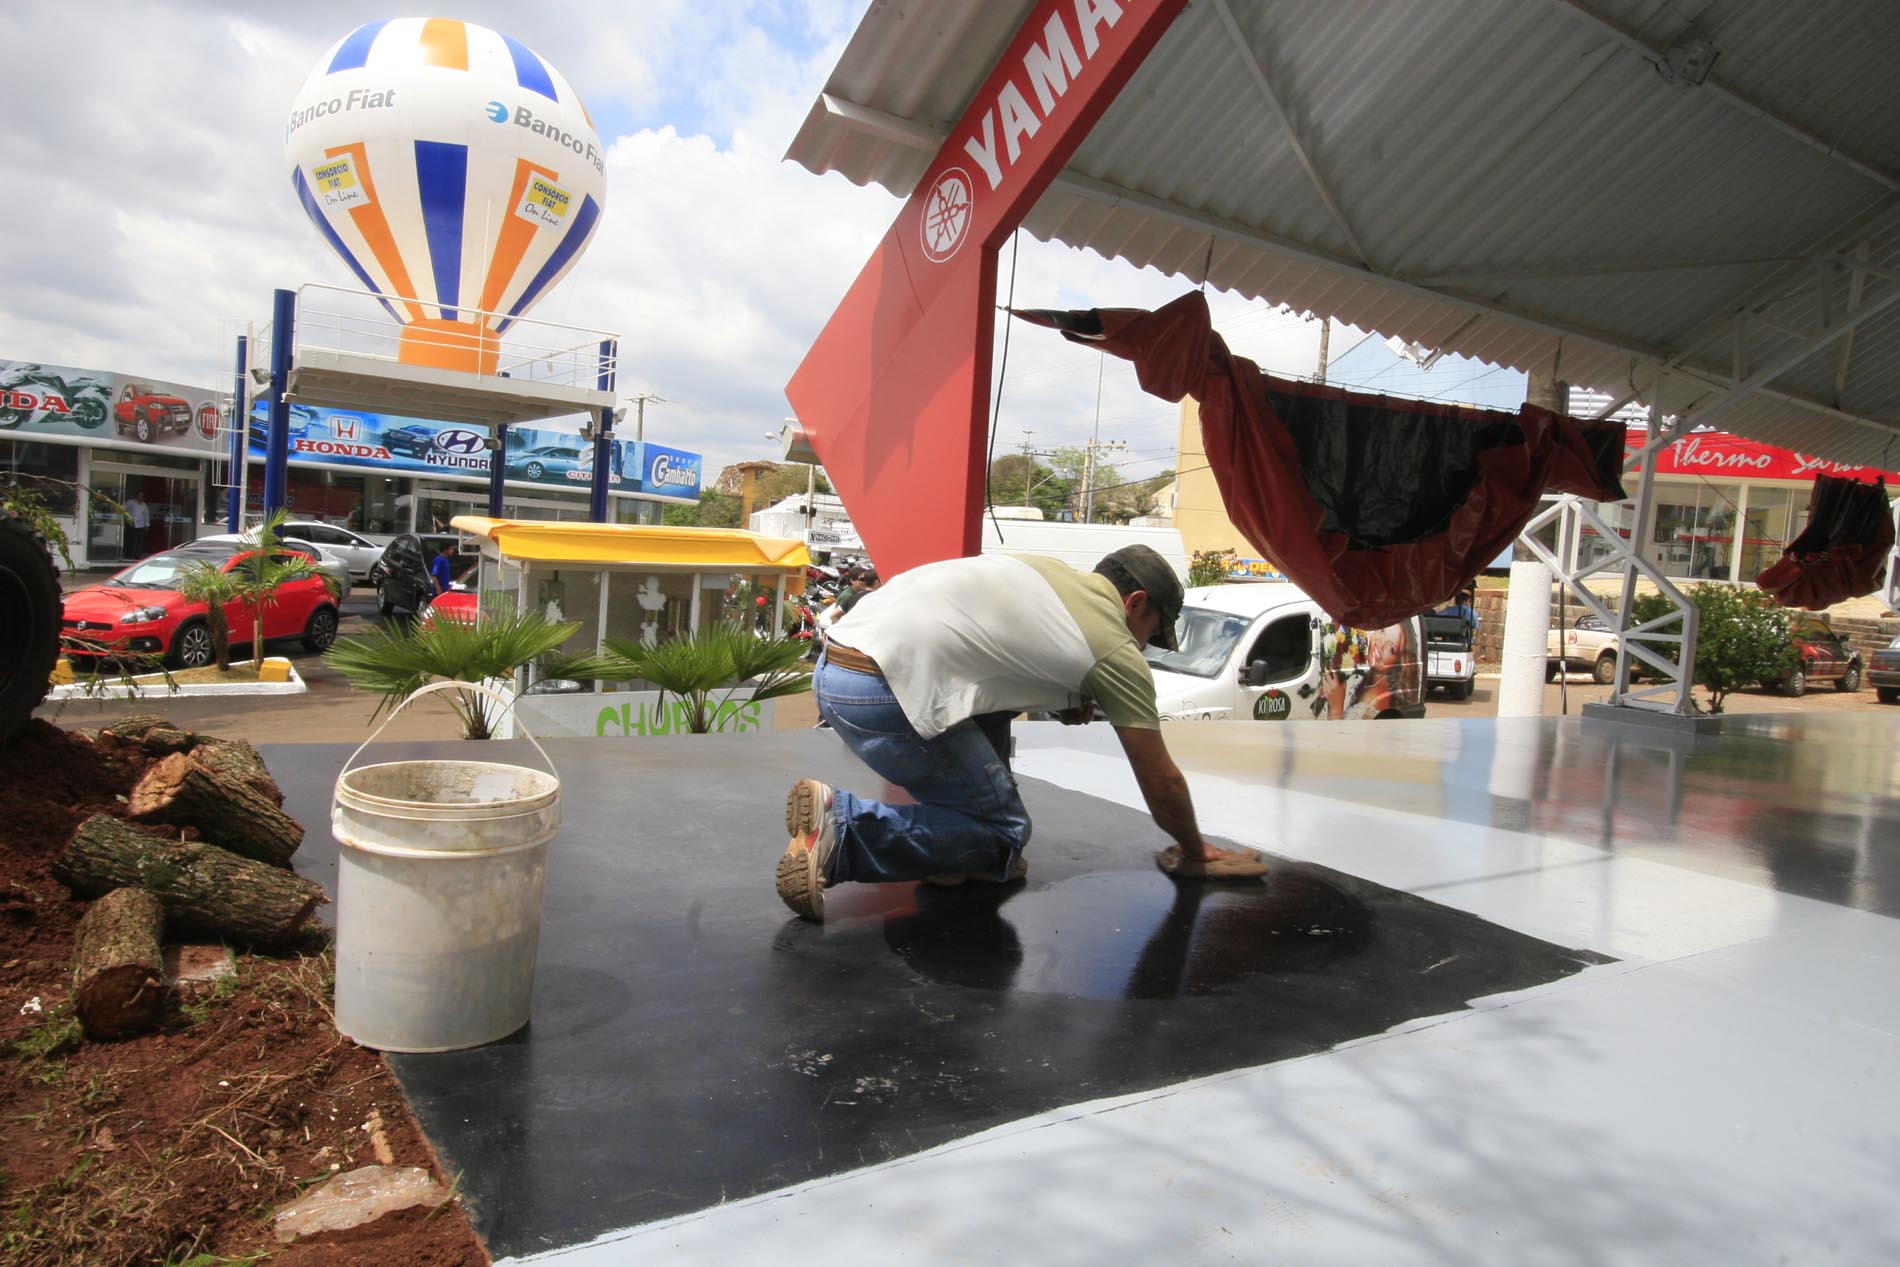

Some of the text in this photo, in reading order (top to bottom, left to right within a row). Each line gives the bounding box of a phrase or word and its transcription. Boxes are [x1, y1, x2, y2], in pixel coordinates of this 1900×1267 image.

[964, 0, 1131, 192] YAMA
[290, 88, 397, 134] Banco Fiat
[513, 106, 584, 154] Banco
[315, 163, 349, 180] CONSORCIO
[534, 182, 569, 204] CONSORCIO
[542, 196, 556, 209] FIAT
[525, 202, 559, 226] On Line
[0, 389, 71, 413] DA
[295, 439, 392, 460] HONDA
[1672, 437, 1772, 468] Thermo
[426, 454, 495, 470] HYUNDA
